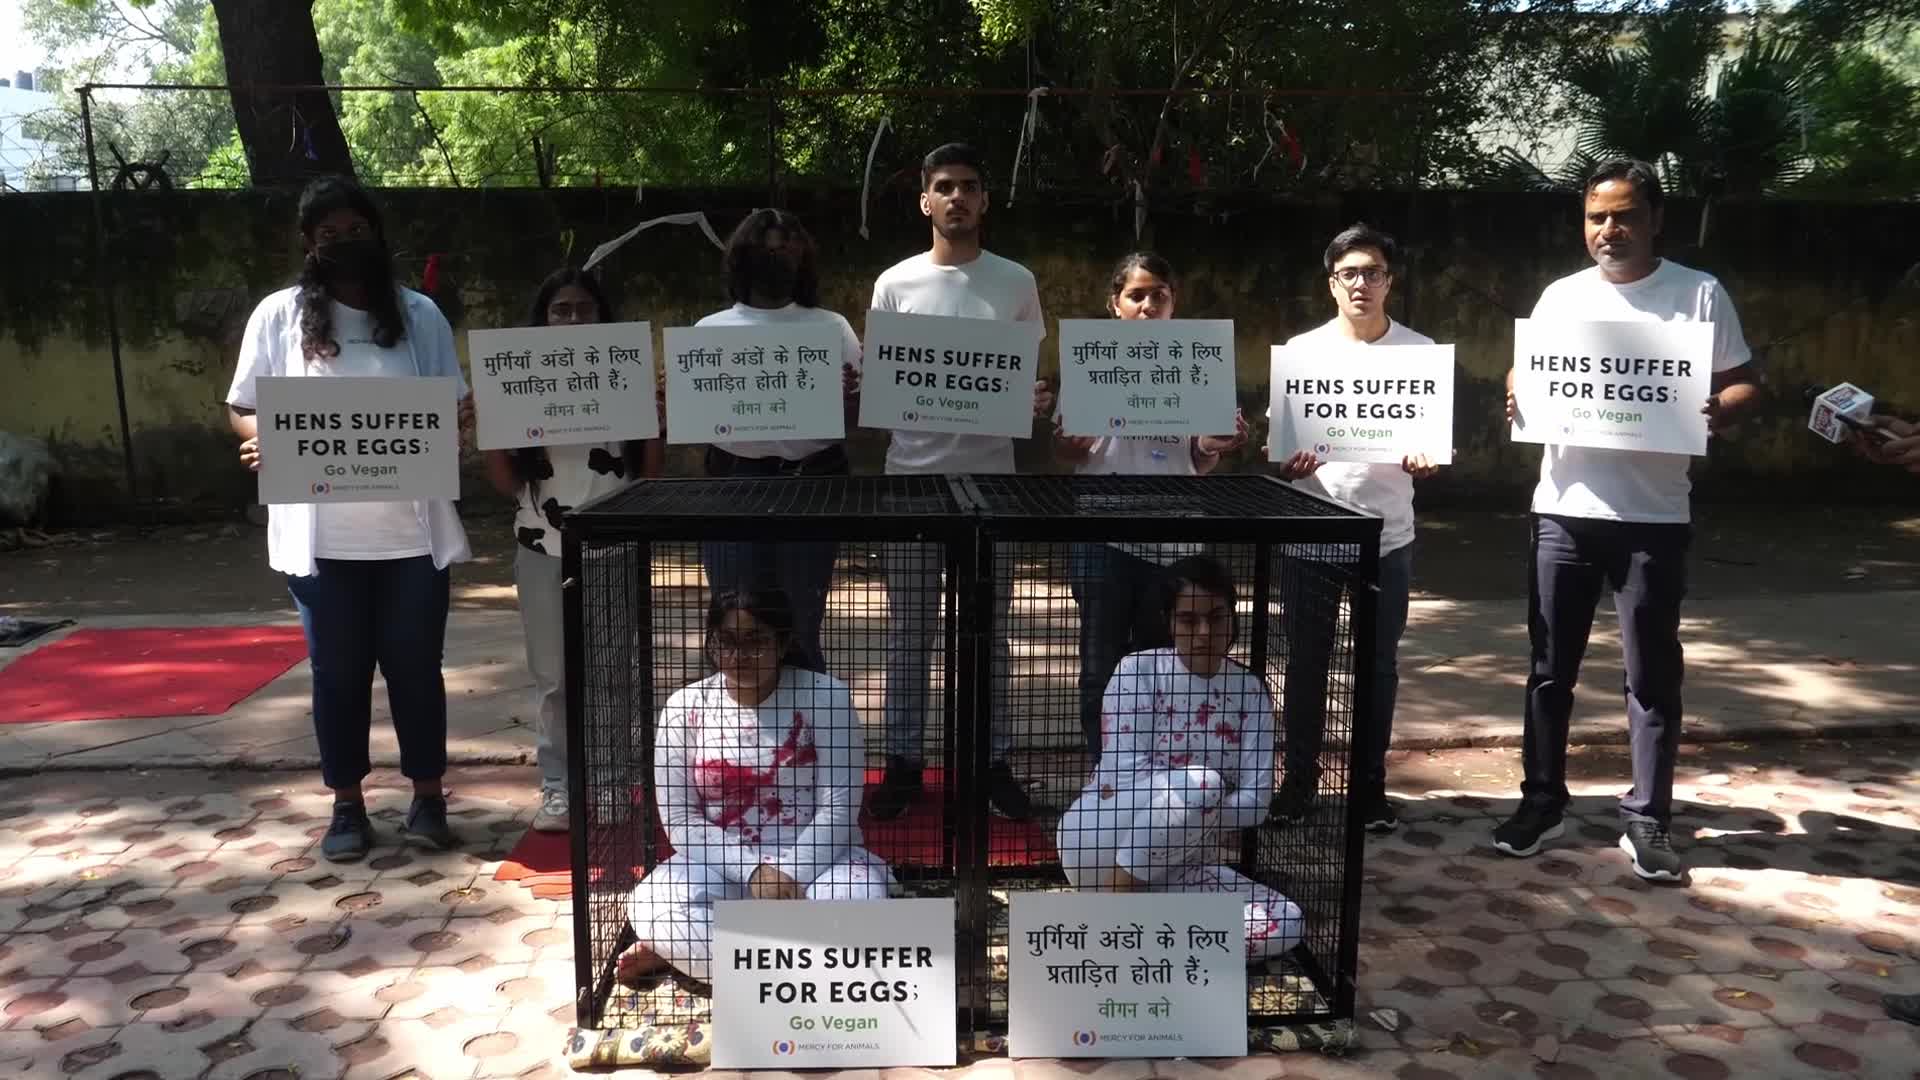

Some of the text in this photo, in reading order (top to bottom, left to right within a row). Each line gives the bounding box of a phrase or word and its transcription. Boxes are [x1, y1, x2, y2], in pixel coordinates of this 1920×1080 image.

[483, 346, 642, 377] मुर्गियाँ अंडों के लिए
[677, 345, 830, 374] मुर्गियाँ अंडों के लिए
[879, 345, 1021, 371] HENS SUFFER
[1072, 340, 1223, 365] मुर्गियाँ अंडों के लिए
[1088, 366, 1143, 387] प्रताड़ित
[1150, 365, 1182, 385] होती
[1531, 356, 1691, 377] HENS SUFFER
[501, 375, 558, 396] प्रताड़ित
[566, 371, 600, 392] होती
[692, 373, 749, 394] प्रताड़ित
[755, 369, 789, 391] होती
[896, 370, 936, 388] FOR
[1286, 379, 1435, 394] HENS SUFFER
[1550, 381, 1593, 399] FOR
[915, 395, 979, 411] Go Vegan
[1304, 403, 1347, 418] FOR
[275, 413, 440, 430] HENS SUFFER
[1572, 408, 1642, 423] Go Vegan
[1326, 426, 1392, 439] Go Vegan
[298, 439, 347, 456] FOR
[324, 464, 397, 477] Go Vegan
[1026, 923, 1230, 956] मुर्गियाँ अंडों के लिए
[734, 944, 932, 970] HENS SUFFER
[1046, 959, 1119, 988] प्रताड़ित
[1130, 957, 1174, 985] होती
[760, 982, 817, 1004] FOR
[1097, 996, 1172, 1019] वीगन बने
[790, 1016, 878, 1032] Go Vegan
[845, 1042, 881, 1051] ANIMALS
[1147, 1032, 1184, 1042] ANIMALS
